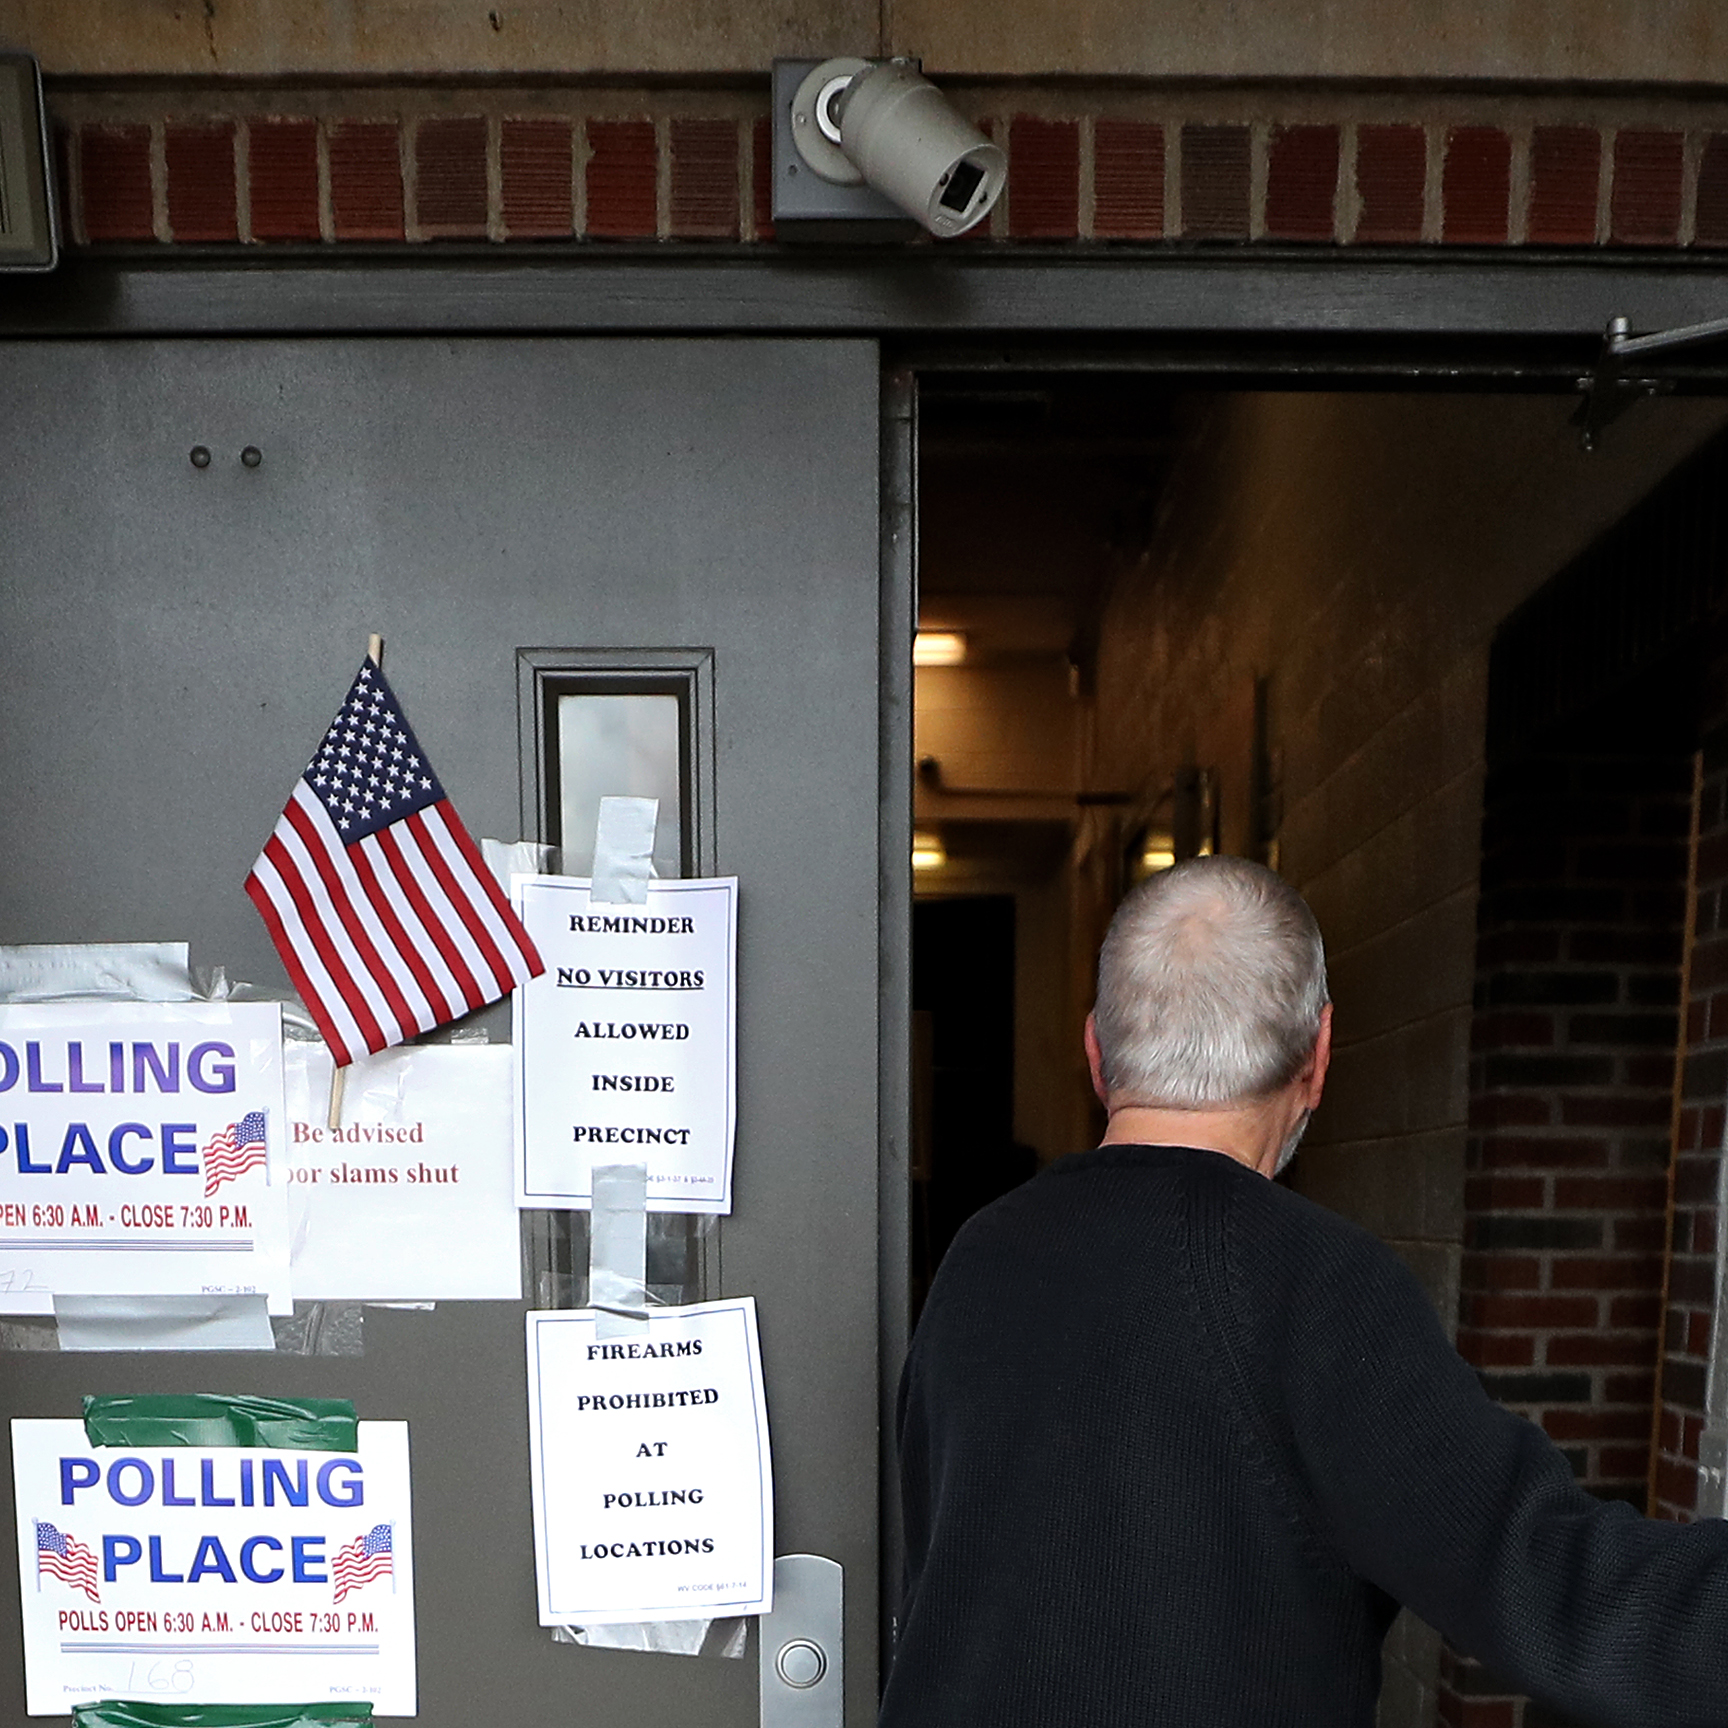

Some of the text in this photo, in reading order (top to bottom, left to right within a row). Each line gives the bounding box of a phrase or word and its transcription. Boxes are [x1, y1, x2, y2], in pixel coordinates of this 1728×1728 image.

[569, 914, 695, 934] REMINDER
[556, 967, 704, 989] NO VISITORS
[574, 1021, 690, 1040] ALLOWED
[592, 1074, 675, 1093] INSIDE
[292, 1122, 424, 1143] Be advised
[573, 1126, 691, 1145] PRECINCT
[287, 1162, 459, 1184] oor slams shut
[32, 1204, 65, 1227] 6:30
[70, 1204, 104, 1227] A.M.
[120, 1204, 175, 1228] CLOSE
[180, 1205, 213, 1228] 7:30
[219, 1205, 252, 1228] P.M.
[587, 1339, 703, 1361] FIREARMS
[577, 1388, 719, 1411] PROHIBITED
[636, 1441, 668, 1458] AT
[59, 1457, 364, 1508] POLLING
[603, 1488, 704, 1509] POLLING
[102, 1534, 328, 1583] PLACE
[580, 1538, 715, 1560] LOCATIONS
[58, 1610, 109, 1632] POLLS
[115, 1610, 158, 1632] OPEN
[163, 1611, 195, 1633] 6:30
[201, 1612, 233, 1632] A.M.
[251, 1611, 304, 1633] CLOSE
[309, 1612, 341, 1633] 7:30
[347, 1612, 378, 1632] P.M.
[126, 1658, 196, 1692] 168
